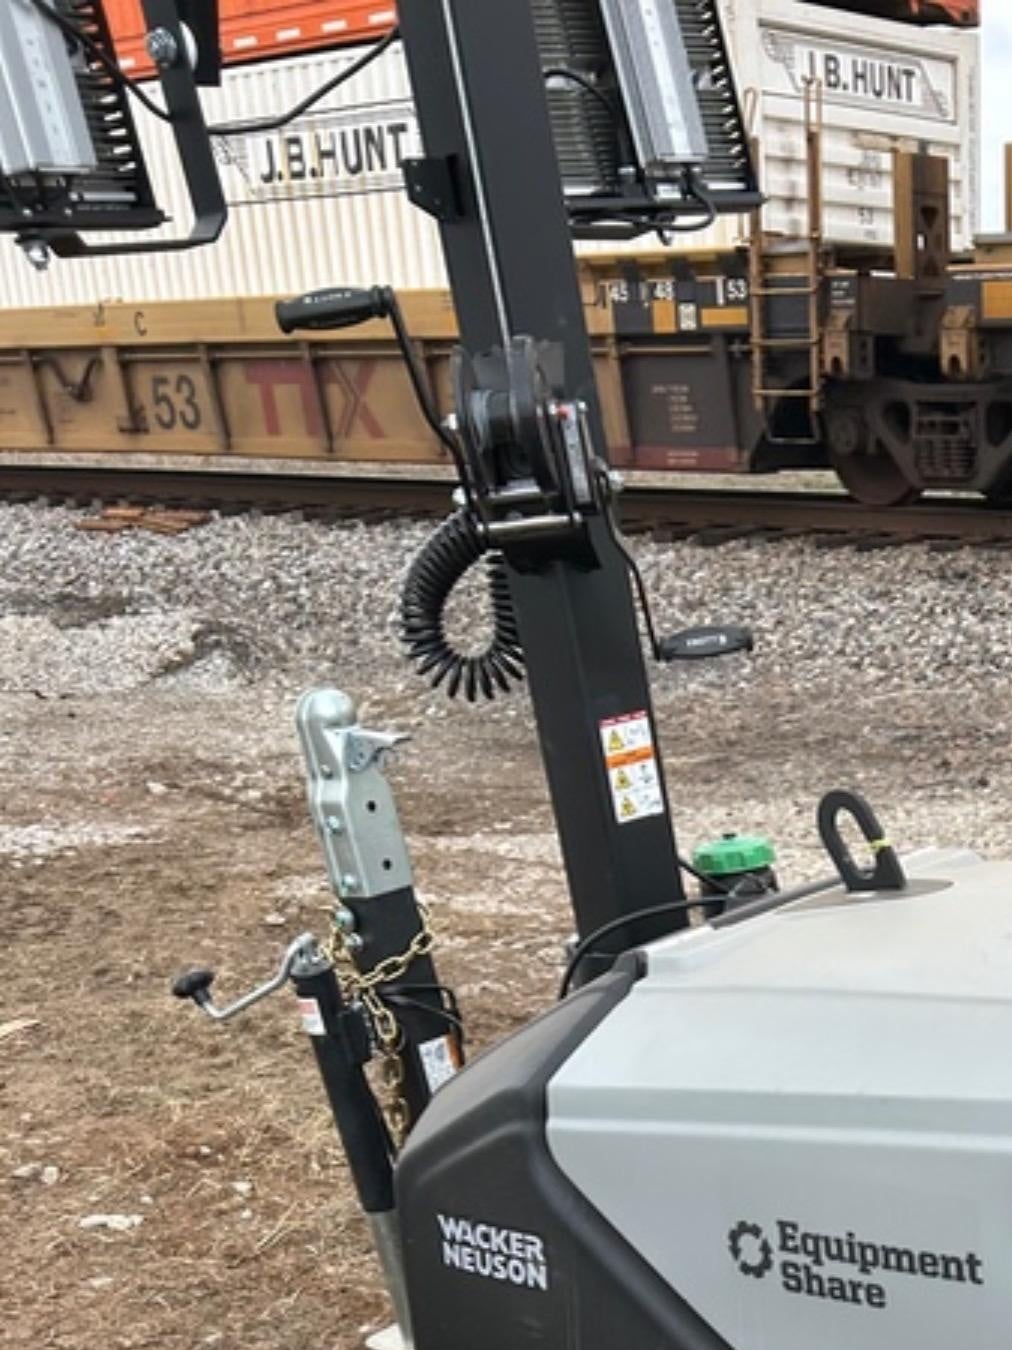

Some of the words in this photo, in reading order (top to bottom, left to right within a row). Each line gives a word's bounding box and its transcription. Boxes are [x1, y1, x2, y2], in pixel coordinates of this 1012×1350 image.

[727, 279, 748, 300] 53
[152, 375, 201, 430] 53
[241, 357, 387, 439] TTX
[437, 1214, 546, 1262] WACKER
[776, 1219, 984, 1285] Equipment
[443, 1241, 548, 1291] NEUSON
[780, 1260, 886, 1309] Share
